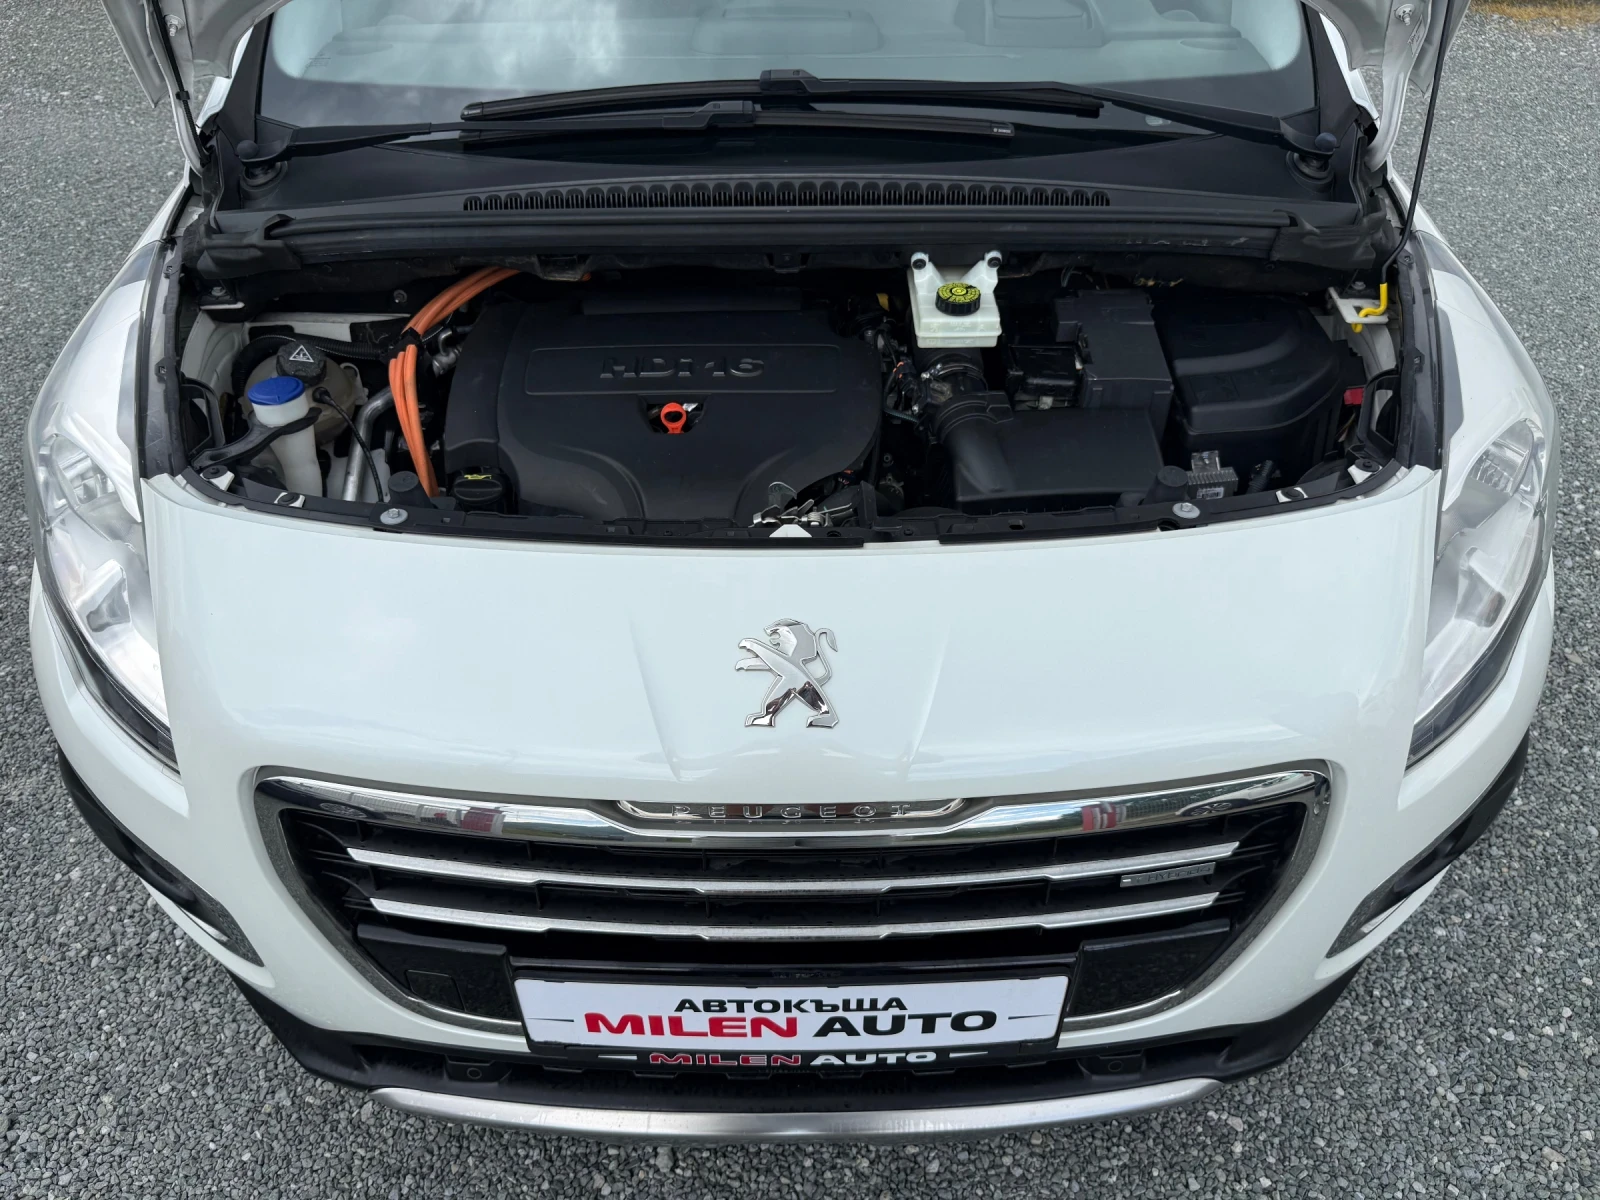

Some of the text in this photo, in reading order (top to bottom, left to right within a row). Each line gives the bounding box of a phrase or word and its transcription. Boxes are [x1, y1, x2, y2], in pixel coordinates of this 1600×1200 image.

[671, 804, 910, 818] PEUGEOT
[584, 1010, 997, 1038] MILEN AUTO
[649, 1051, 937, 1066] MILEN AUTO
